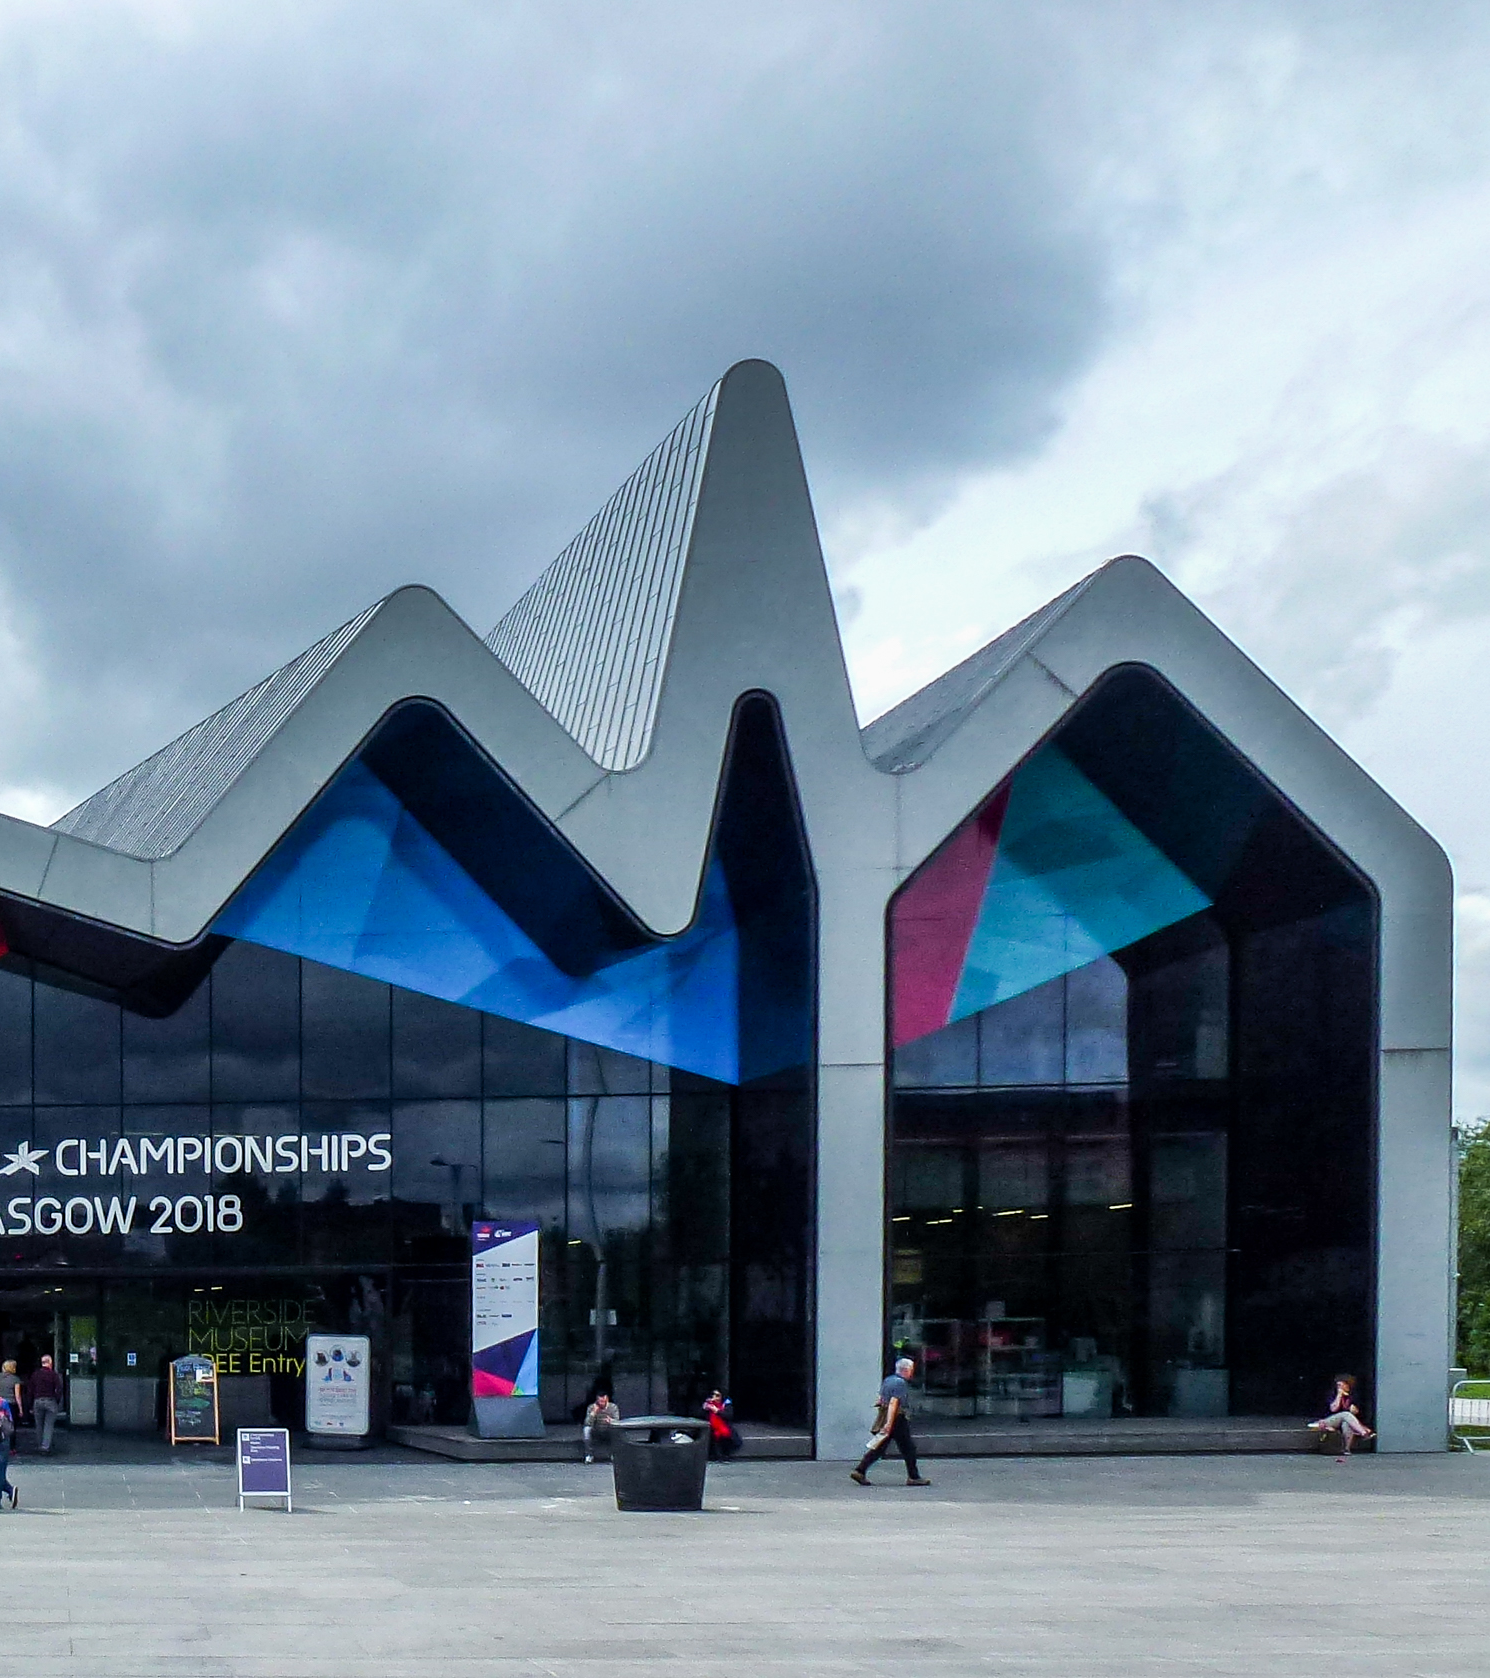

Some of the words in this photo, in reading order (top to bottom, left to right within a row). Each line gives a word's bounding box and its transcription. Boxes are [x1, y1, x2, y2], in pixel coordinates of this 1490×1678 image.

[56, 1133, 392, 1175] CHAMPIONSHIPS
[150, 1195, 243, 1234] 2018
[188, 1299, 317, 1325] RIVERSIDE
[188, 1326, 310, 1352] MUSEUM
[249, 1352, 306, 1378] Entry
